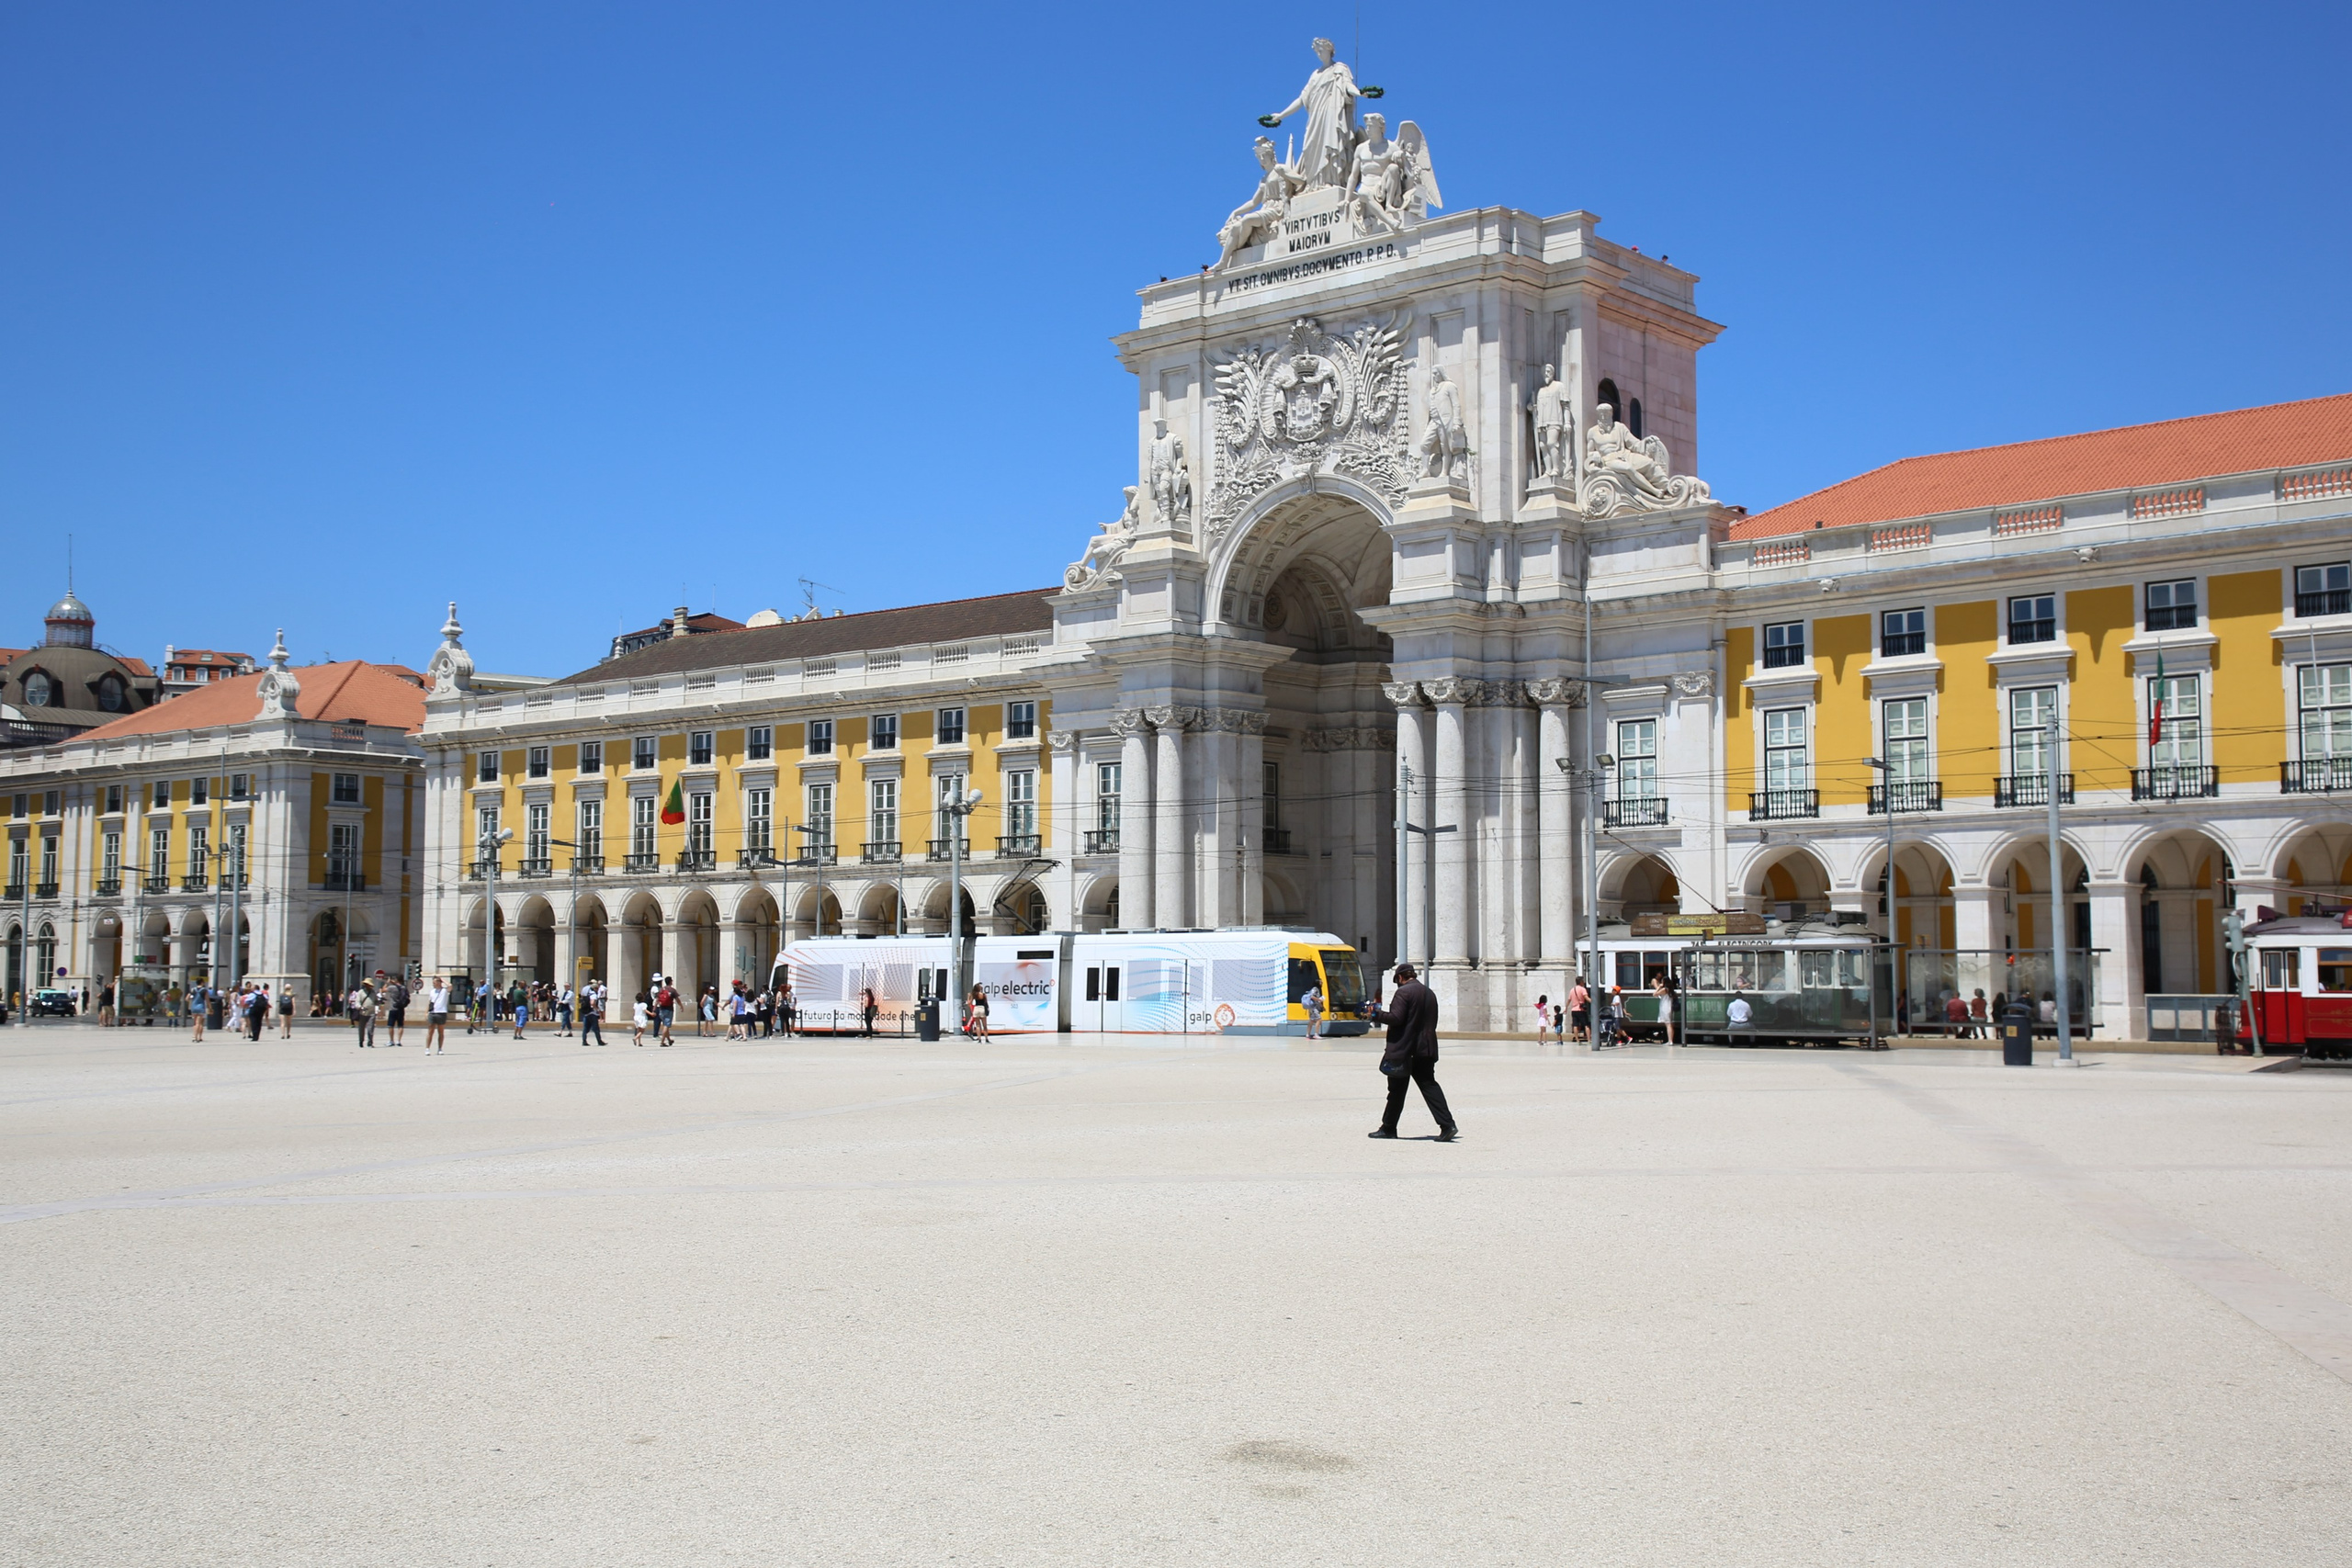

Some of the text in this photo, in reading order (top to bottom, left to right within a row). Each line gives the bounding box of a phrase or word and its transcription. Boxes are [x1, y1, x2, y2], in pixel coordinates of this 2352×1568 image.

[1284, 210, 1340, 235] VIRTVTIBVS
[1288, 231, 1331, 253] MAIORVM
[983, 980, 1050, 998] alp electric
[804, 1010, 832, 1021] futuro
[1189, 1010, 1212, 1024] galp
